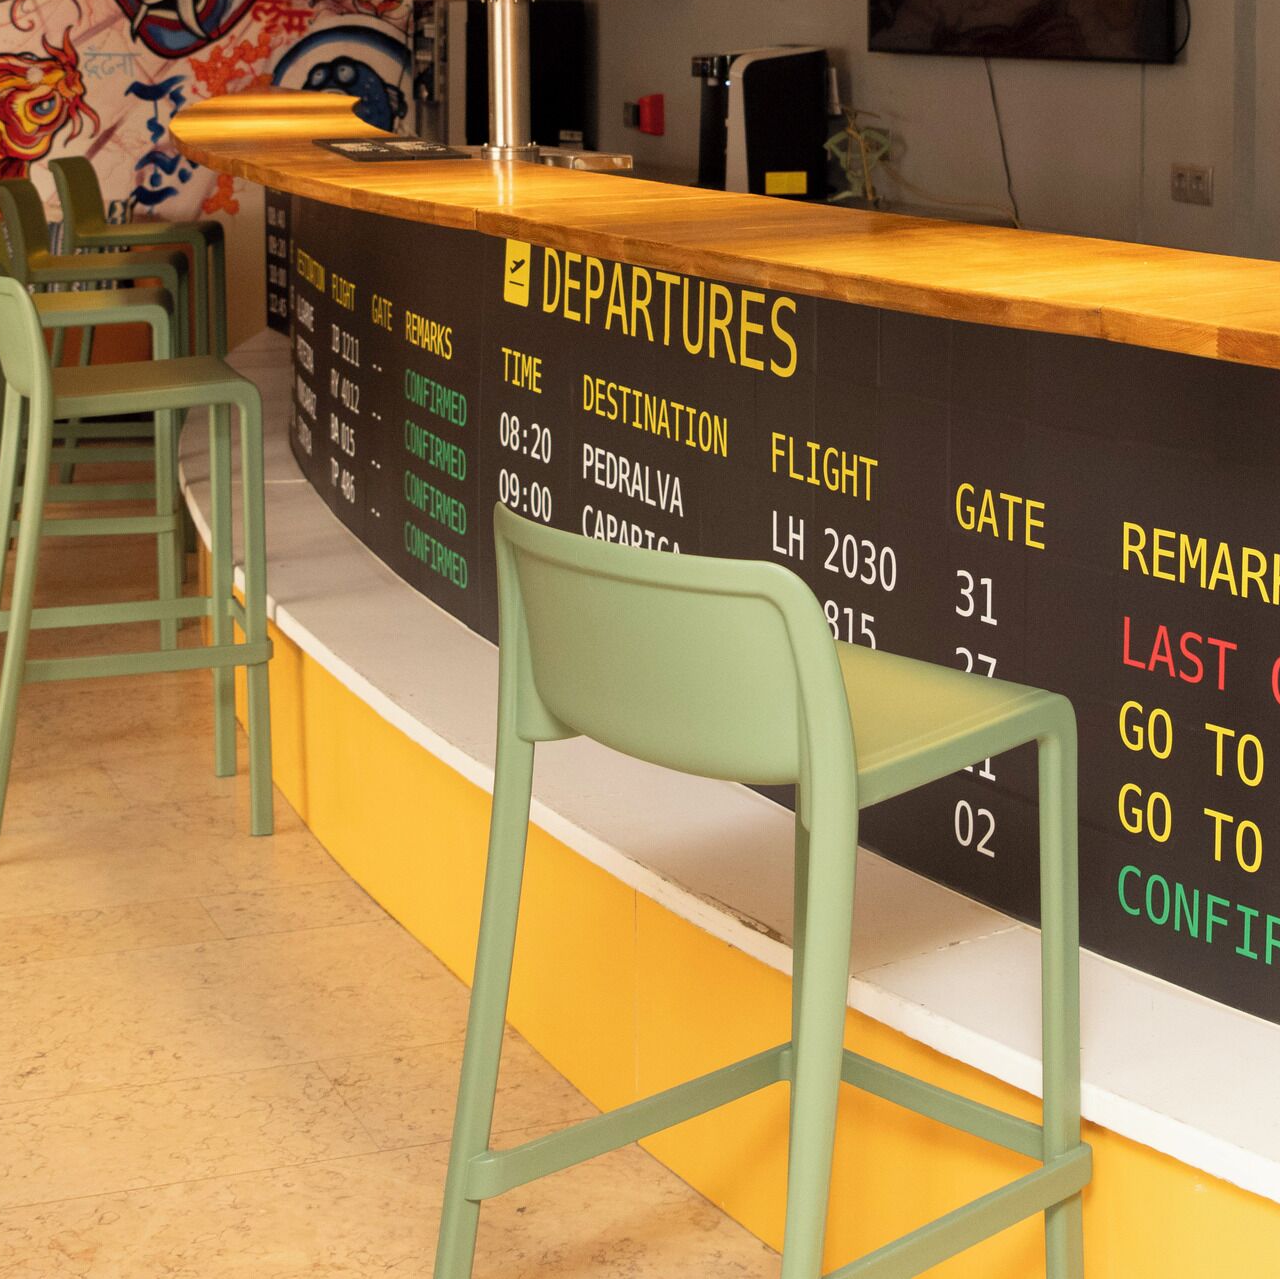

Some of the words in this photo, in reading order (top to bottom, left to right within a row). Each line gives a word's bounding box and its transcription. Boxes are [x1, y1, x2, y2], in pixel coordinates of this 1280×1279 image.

[331, 272, 357, 311] FLIGHT
[371, 293, 393, 333] GATE
[405, 310, 453, 360] REMARKS
[542, 246, 798, 379] DEPARTURES
[341, 331, 360, 368] 1211
[405, 368, 467, 428] CONFIRMED
[341, 377, 360, 415] 4012
[405, 419, 467, 482] CONFIRMED
[341, 422, 356, 457] 015
[405, 469, 467, 536] CONFIRMED
[501, 347, 542, 394] TIME
[583, 374, 728, 458] DESTINATION
[771, 431, 879, 501] FLIGHT
[955, 482, 1046, 550] GATE
[405, 520, 468, 591] CONFIRMED
[499, 411, 552, 464] 08:20
[582, 442, 684, 518] PEDRALVA
[772, 510, 805, 561] LH
[824, 527, 897, 592] 2030
[955, 569, 998, 626] 31
[1121, 616, 1238, 691] LAST
[498, 468, 552, 523] 09:00
[1119, 700, 1173, 760] GO
[1204, 722, 1264, 787] TO
[954, 799, 996, 858] 02
[1118, 782, 1172, 843] GO
[1203, 807, 1263, 873] TO
